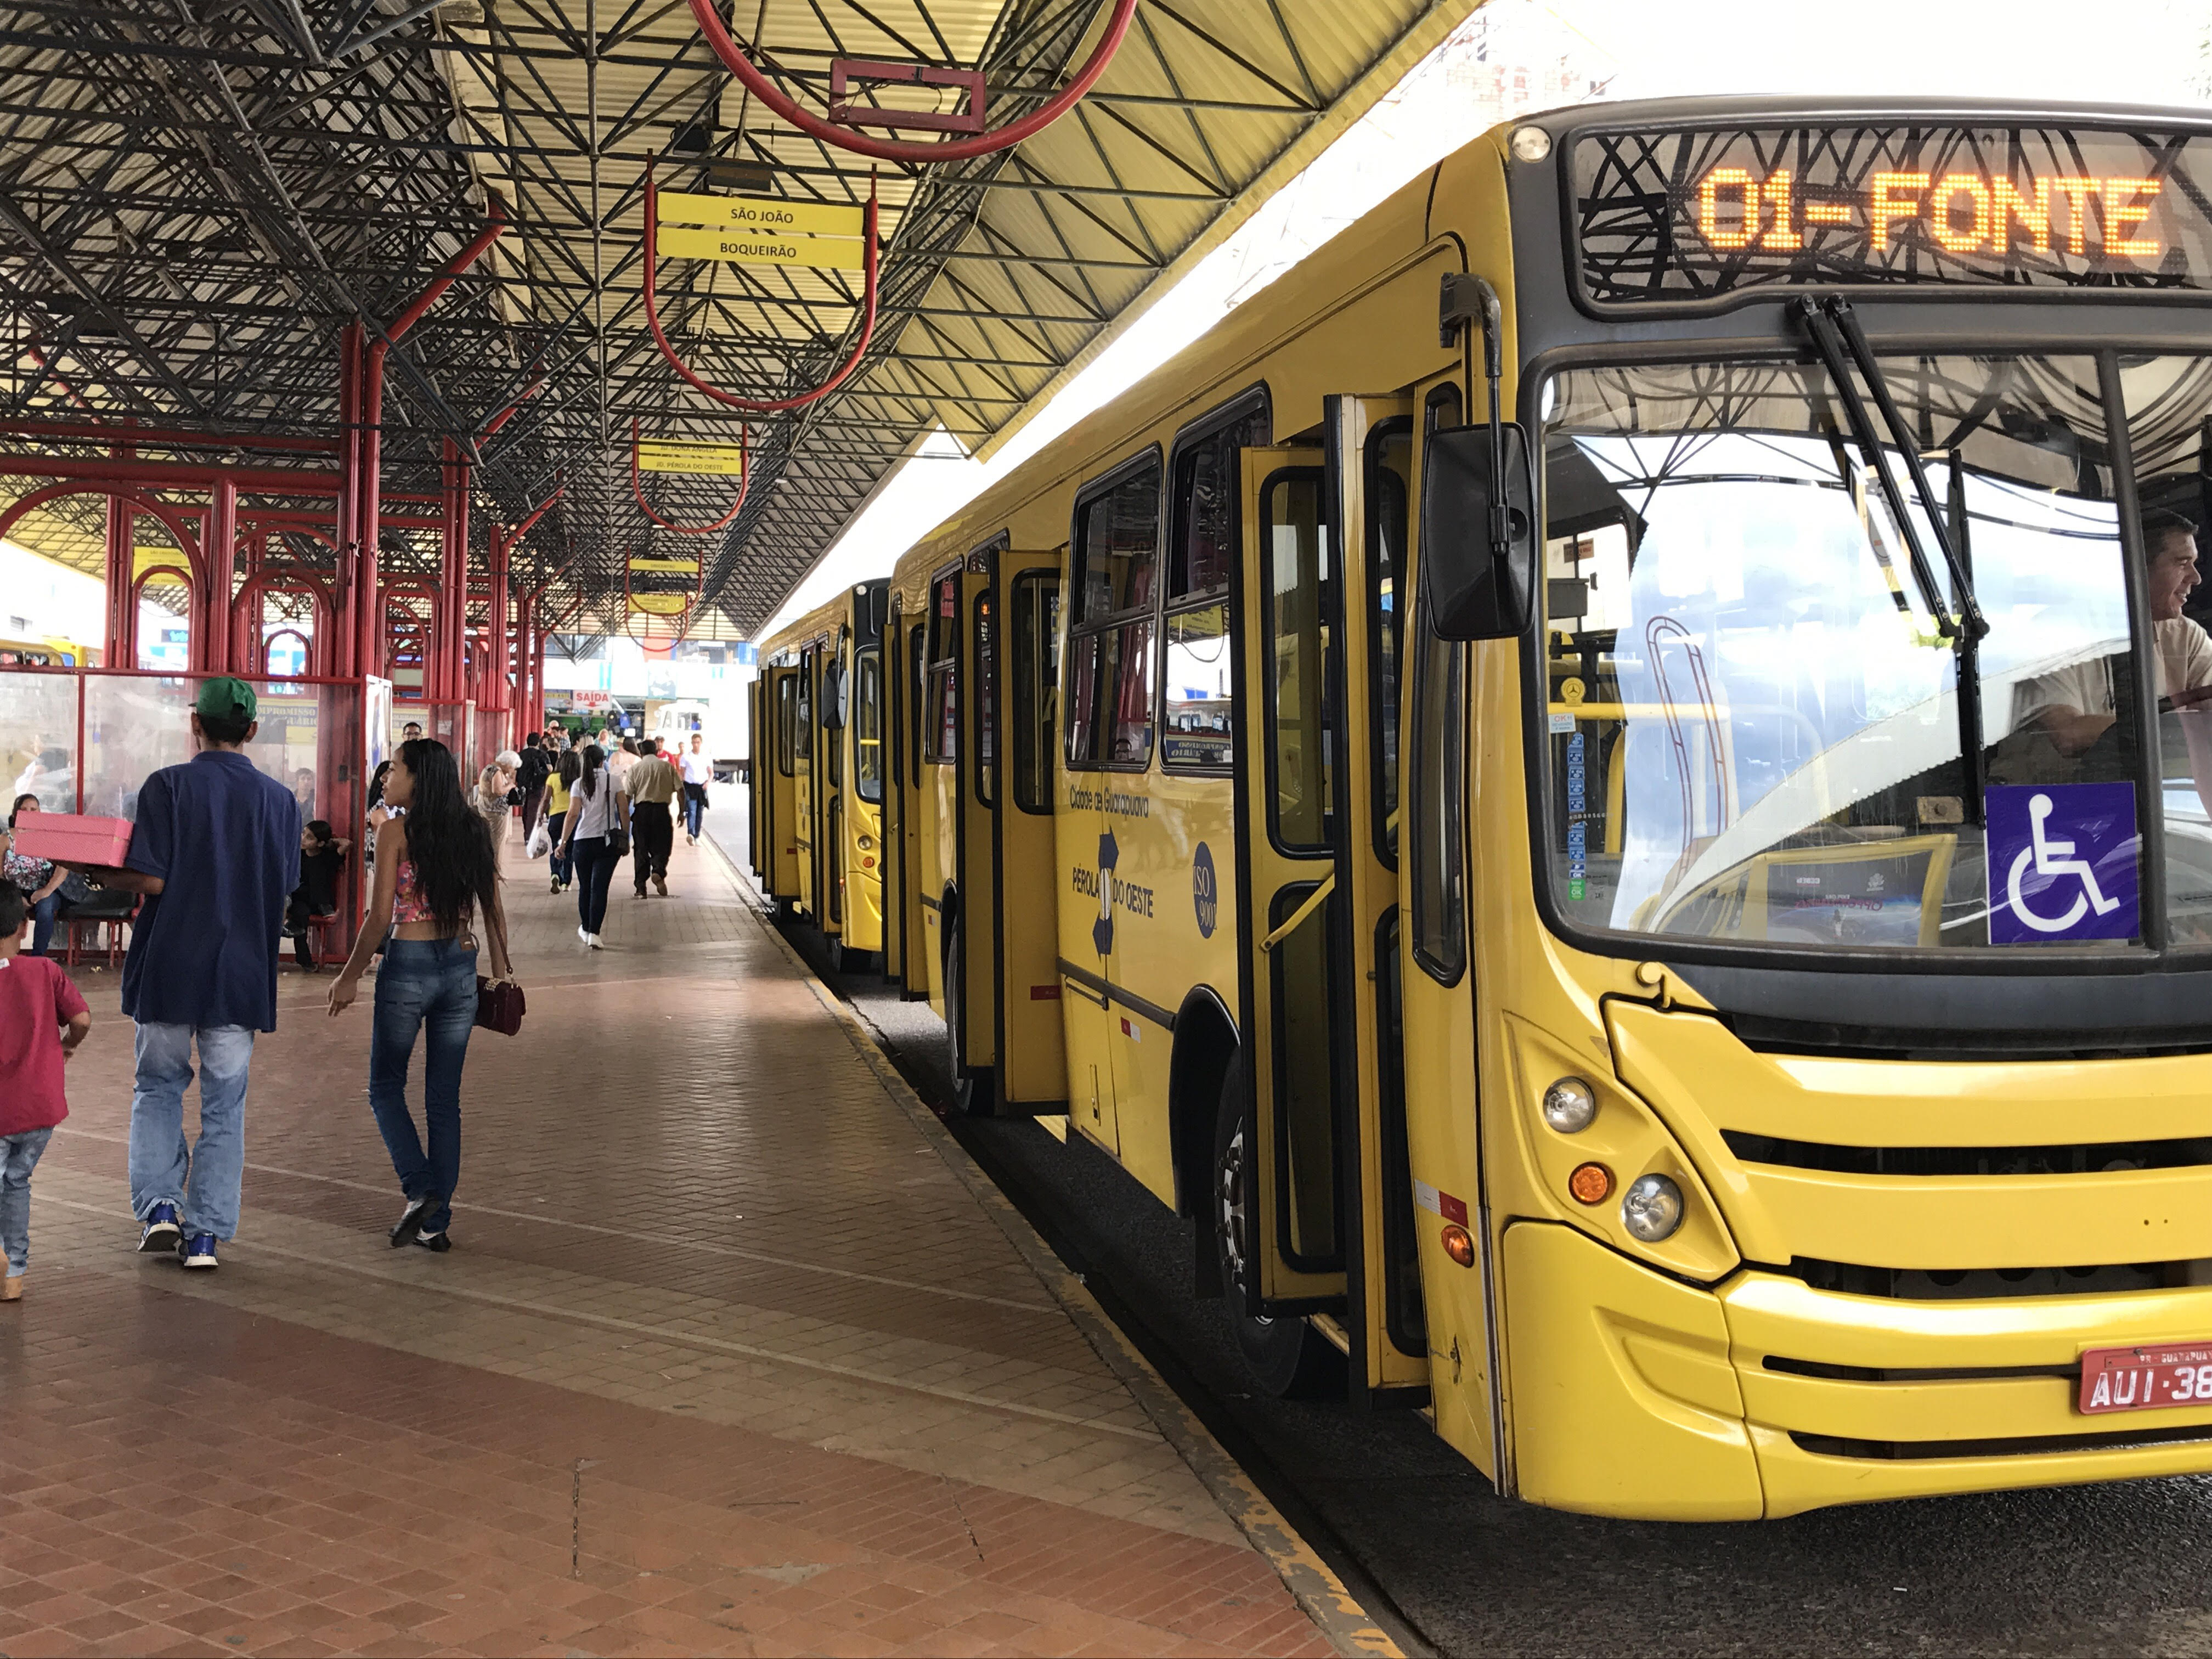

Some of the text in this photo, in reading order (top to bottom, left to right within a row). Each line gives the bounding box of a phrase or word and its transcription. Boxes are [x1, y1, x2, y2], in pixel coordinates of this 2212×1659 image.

[731, 207, 794, 224] SÃO JOÃO
[1870, 173, 2162, 256] FONTE
[720, 242, 797, 258] BOQUEIRÃO
[577, 691, 609, 702] SAÍDA
[1070, 785, 1093, 810] Cidade
[1104, 786, 1149, 821] Guarapuava
[1073, 863, 1154, 918] PÉROLA DO OESTE
[1193, 865, 1210, 897] ISO
[1199, 900, 1217, 930] 9001
